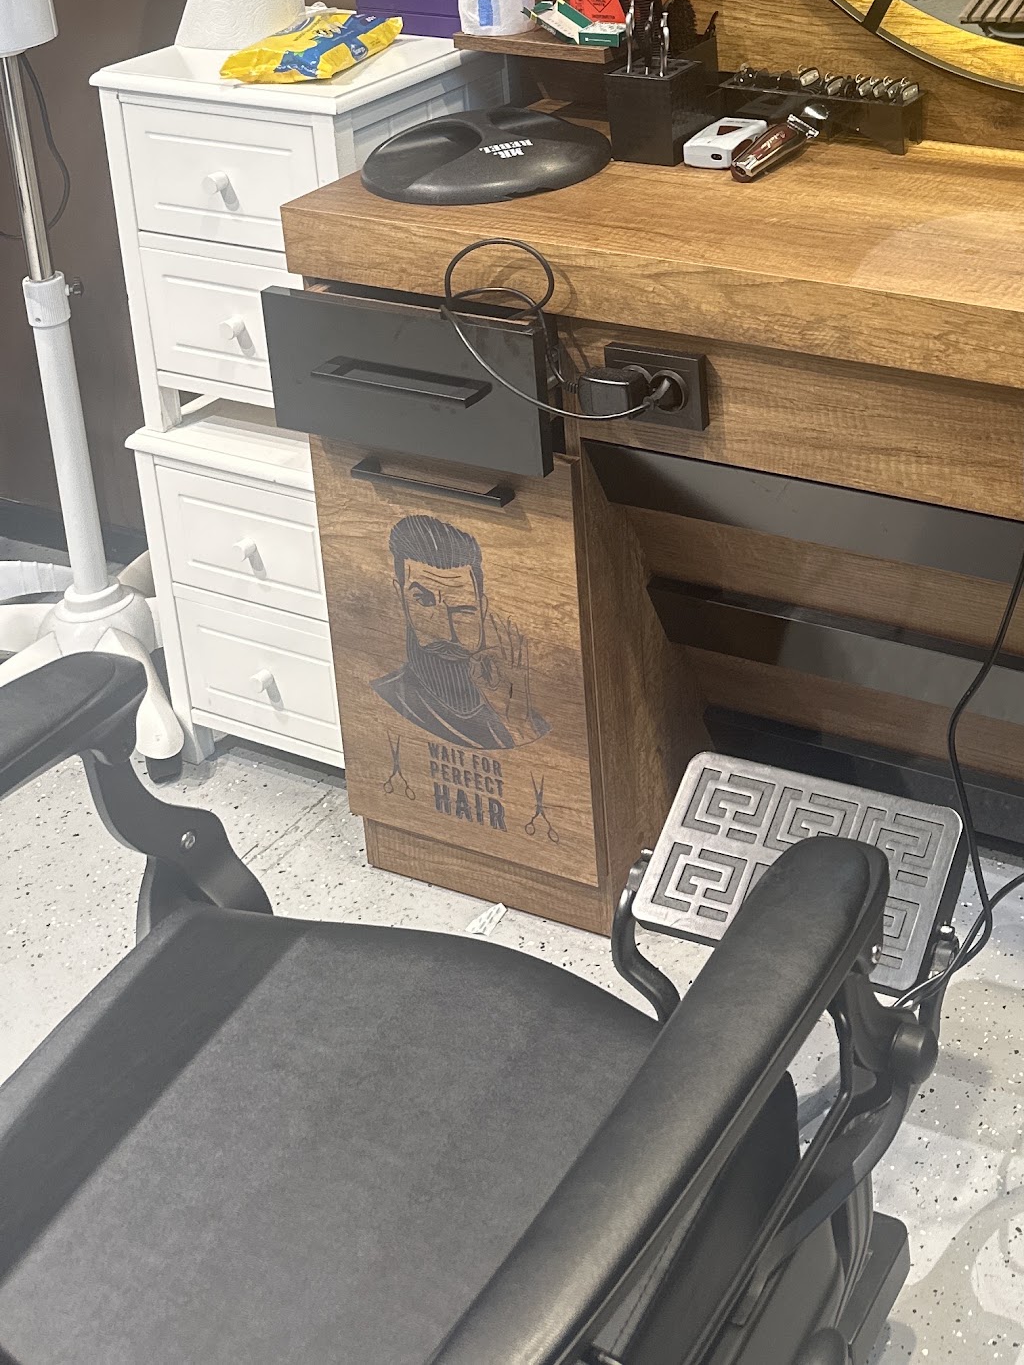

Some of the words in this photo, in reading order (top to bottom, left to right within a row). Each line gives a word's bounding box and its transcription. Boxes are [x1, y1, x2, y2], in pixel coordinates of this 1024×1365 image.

[479, 139, 534, 154] REBEL
[428, 741, 466, 765] WAIT
[472, 754, 503, 777] FOR
[429, 760, 504, 798] PERFECT
[433, 781, 508, 832] HAIR
